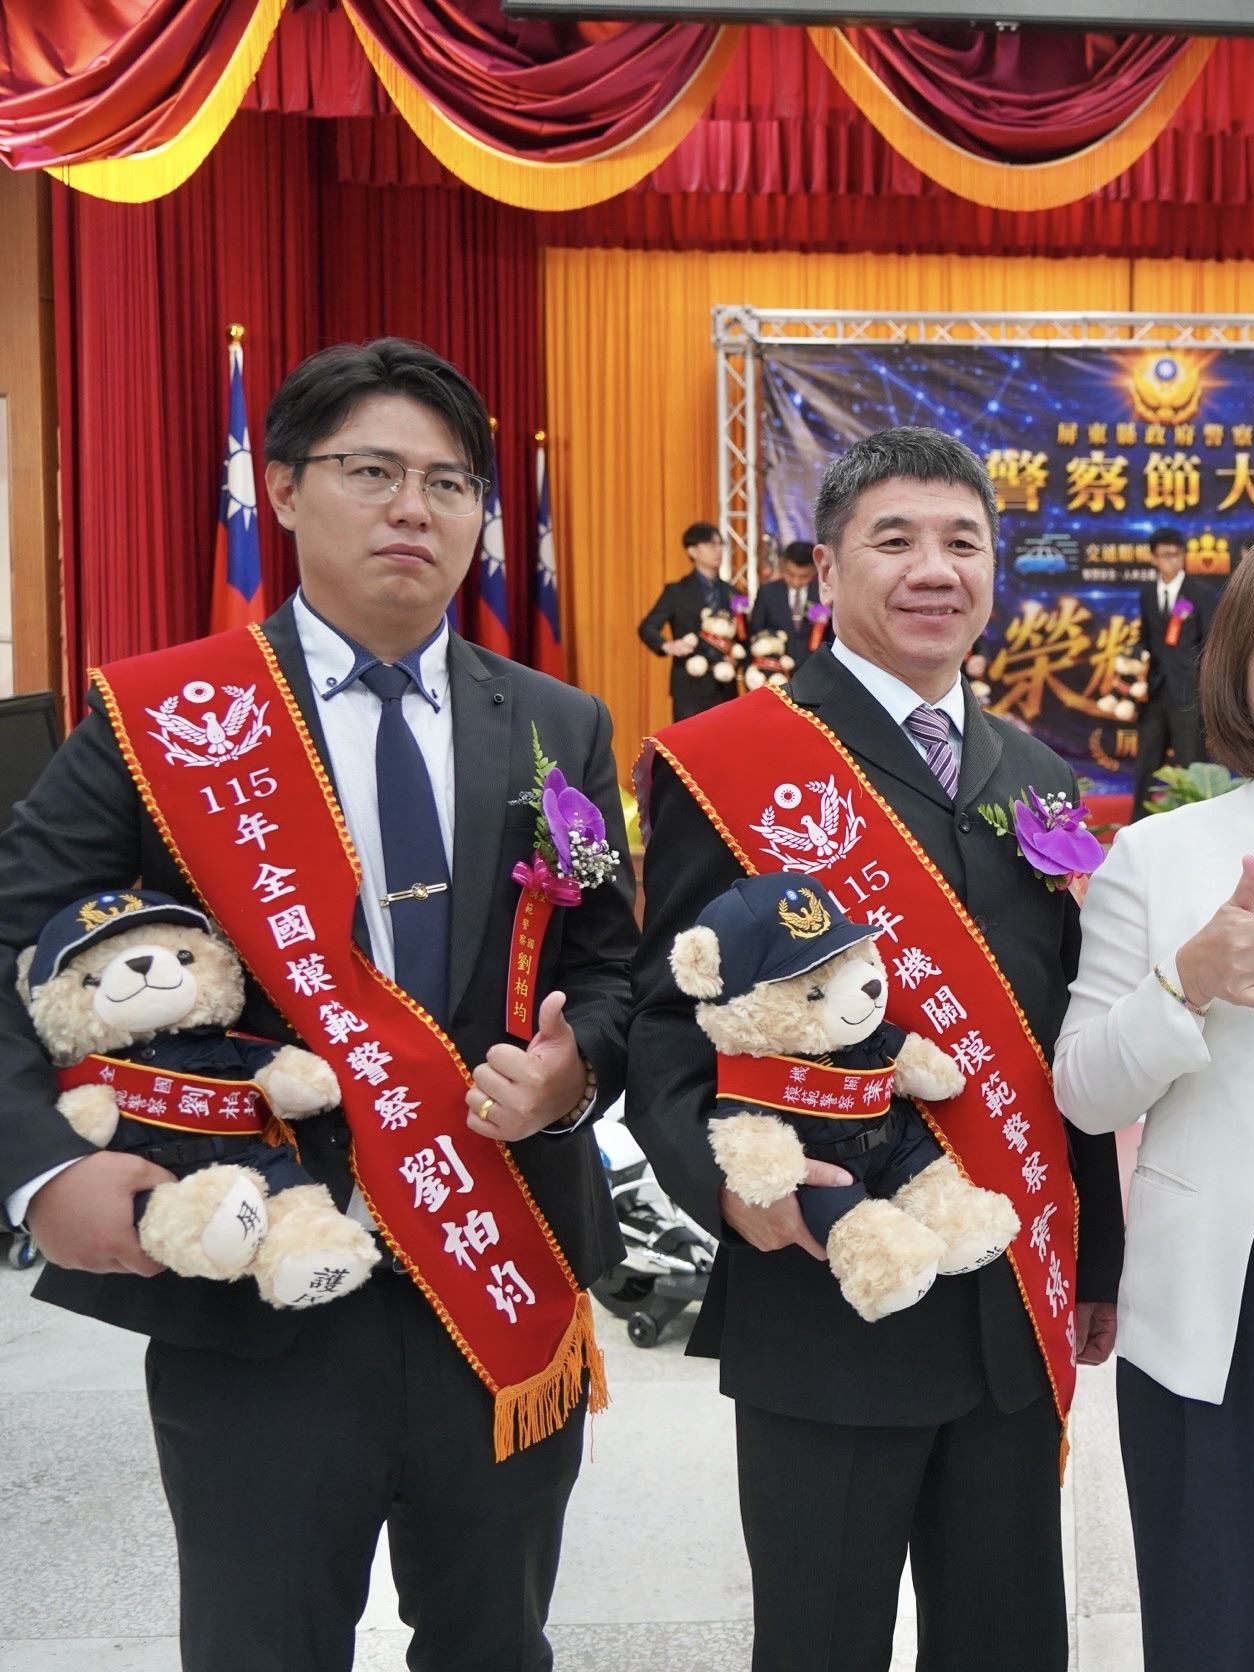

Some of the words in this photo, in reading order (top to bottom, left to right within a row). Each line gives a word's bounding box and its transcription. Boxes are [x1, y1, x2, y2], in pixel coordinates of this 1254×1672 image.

[513, 952, 532, 1023] 劉柏均
[178, 1085, 262, 1119] 劉柏均
[399, 1134, 536, 1325] 劉柏均
